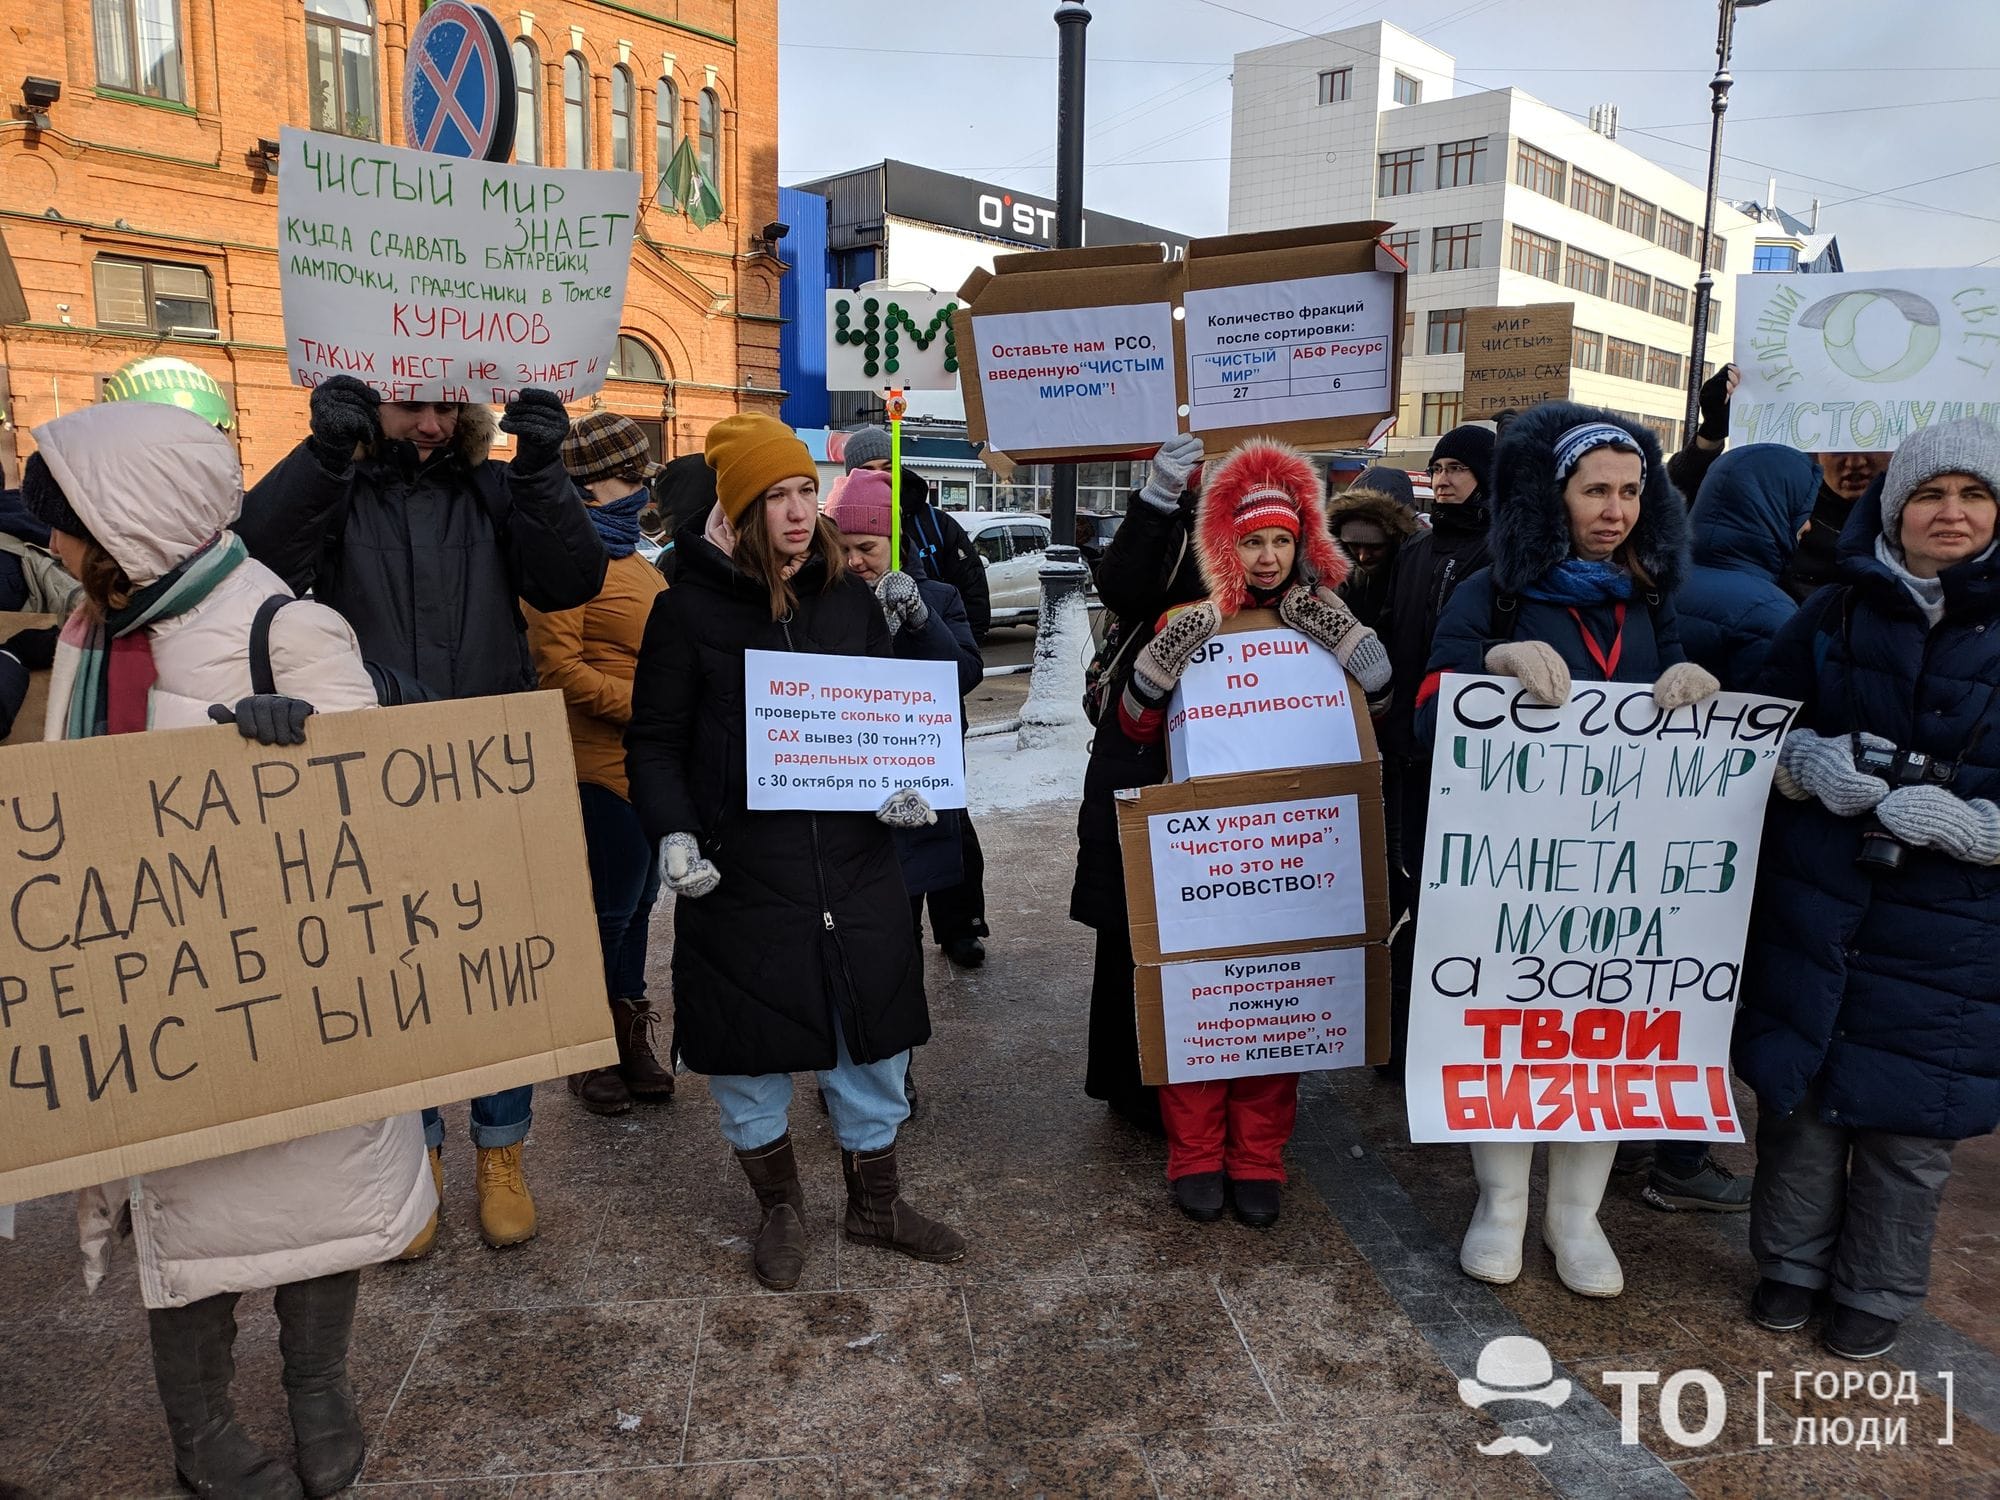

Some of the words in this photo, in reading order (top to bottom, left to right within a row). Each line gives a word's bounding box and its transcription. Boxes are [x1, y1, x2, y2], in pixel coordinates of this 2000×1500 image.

[303, 140, 453, 206] ЧИСТЫЙ
[483, 178, 564, 213] МИР
[287, 216, 352, 251] КУДА
[371, 230, 466, 264] СДАВАТЬ
[505, 214, 629, 251] ЗНАЕТ
[290, 255, 398, 293] ЛАМПОЧКИ,
[411, 275, 526, 304] ГРАДУСНИКИ
[559, 281, 612, 303] Томске
[393, 302, 550, 344] КУРИЛОВ
[1207, 307, 1295, 328] Количество
[1299, 301, 1365, 321] фракций
[1216, 331, 1262, 346] после
[1264, 322, 1356, 344] сортировки:
[992, 340, 1069, 359] Оставьте
[1074, 339, 1105, 354] нам
[1114, 335, 1157, 353] РСО,
[1330, 340, 1383, 358] Ресурс
[299, 338, 375, 372] ТАКИХ
[392, 355, 454, 379] МЕСТ
[517, 359, 578, 383] ЗНАЕТ
[1470, 367, 1526, 381] МЕТОДЫ
[1534, 363, 1563, 379] САХ
[443, 386, 470, 403] НА
[1233, 386, 1249, 400] 27
[1333, 377, 1341, 390] 6
[1241, 638, 1310, 664] реши
[769, 680, 815, 699] МЭР,
[820, 686, 937, 705] прокуратура,
[1227, 672, 1259, 691] по
[755, 706, 836, 722] проверьте
[841, 710, 900, 722] сколько
[905, 713, 914, 723] и
[918, 712, 952, 726] куда
[1168, 690, 1346, 733] справедливости!
[767, 729, 800, 742] САХ
[805, 734, 853, 744] вывез
[857, 732, 879, 748] (30
[883, 733, 942, 748] тонн??)
[774, 753, 868, 766] раздельных
[873, 755, 936, 767] отходов
[149, 730, 536, 838] КАРТОНКУ
[758, 777, 766, 787] с
[770, 775, 787, 787] 30
[792, 776, 854, 788] октября
[859, 778, 876, 789] по
[881, 777, 889, 788] 5
[894, 777, 954, 790] ноября.
[1167, 816, 1211, 835] САХ
[1216, 813, 1276, 833] украл
[1283, 805, 1340, 825] сетки
[1208, 861, 1234, 877] но
[1239, 858, 1274, 874] это
[1279, 855, 1304, 871] не
[1661, 840, 1739, 894] БЕЗ
[11, 845, 228, 953] СДАМ
[275, 821, 373, 904] НА
[1181, 872, 1336, 902] ВОРОВСТВО!?
[1224, 959, 1301, 978] Курилов
[1191, 975, 1336, 999] распространяет
[1229, 995, 1300, 1012] ложную
[9, 948, 431, 1110] ЧИСТЫЙ
[459, 934, 556, 1016] МИР
[1197, 1013, 1317, 1034] информацию
[1321, 1011, 1332, 1022] о
[1325, 1026, 1347, 1038] но
[1464, 1007, 1681, 1060] ТВОЙ
[1186, 1053, 1215, 1067] это
[1220, 1051, 1240, 1063] не
[1245, 1040, 1345, 1062] КЛЕВЕТА!?
[1442, 1064, 1736, 1133] БИЗНЕС!
